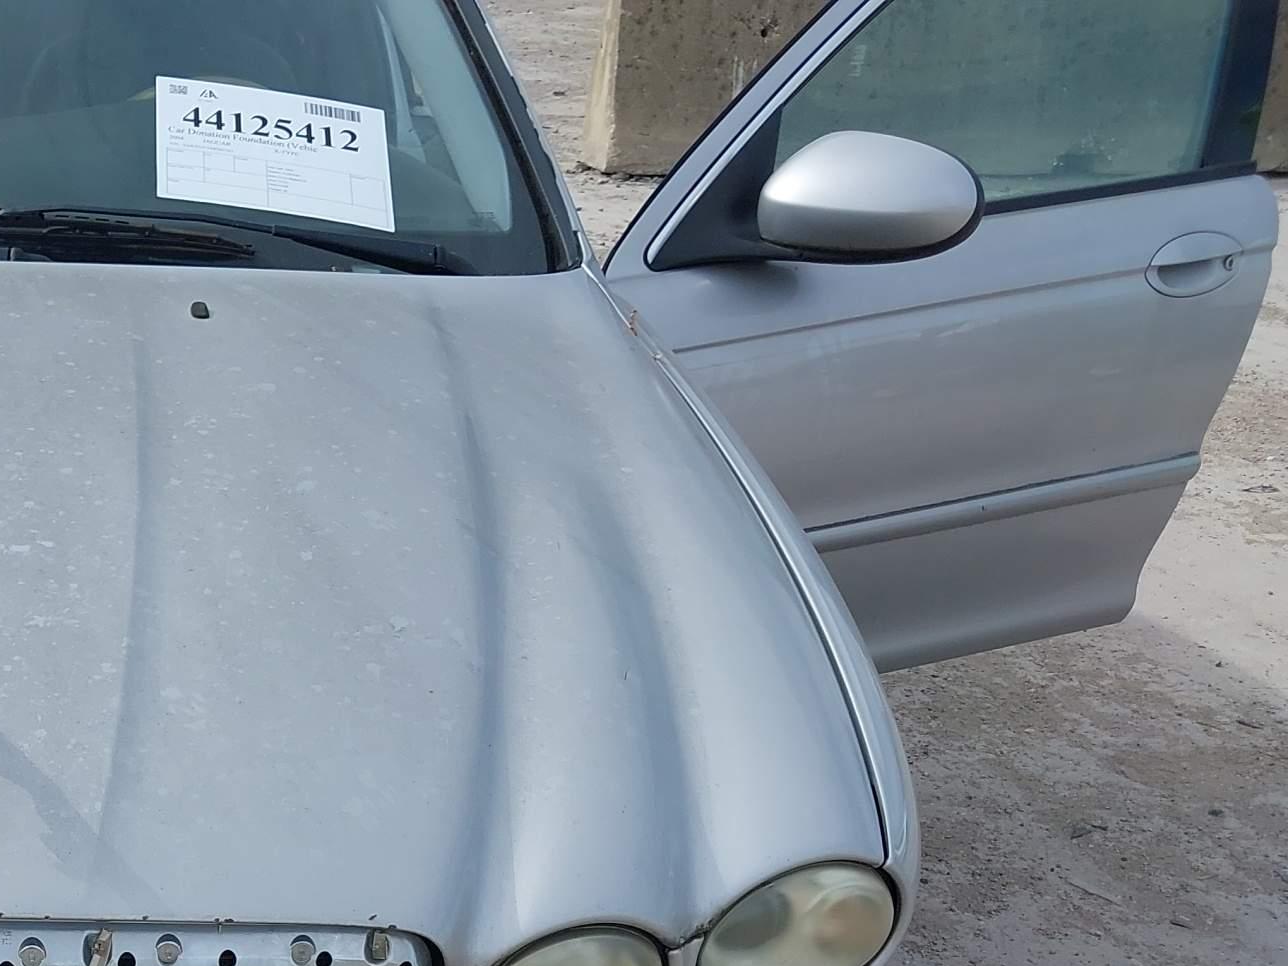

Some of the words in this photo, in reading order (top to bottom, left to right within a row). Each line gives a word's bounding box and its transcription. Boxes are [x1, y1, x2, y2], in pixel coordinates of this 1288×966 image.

[168, 126, 185, 134] Car
[188, 128, 231, 140] Donation
[233, 133, 285, 147] Foundation
[182, 106, 360, 152] 44125412
